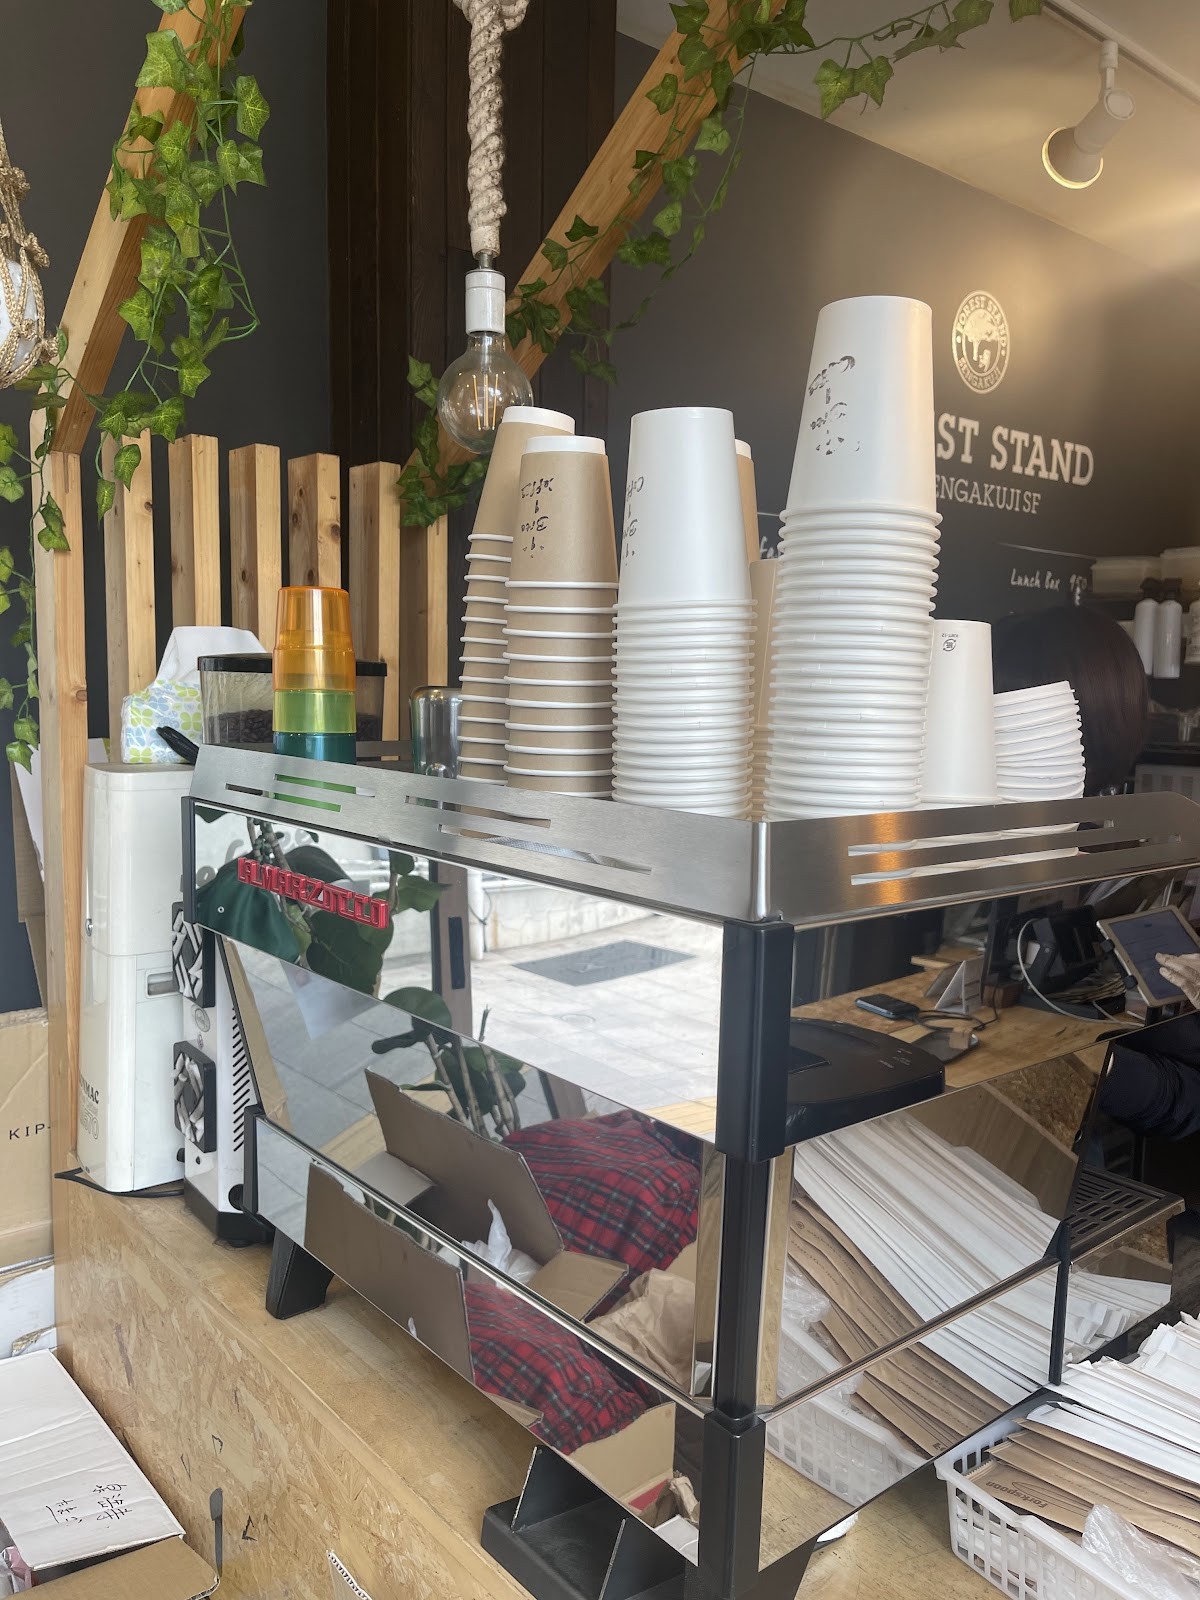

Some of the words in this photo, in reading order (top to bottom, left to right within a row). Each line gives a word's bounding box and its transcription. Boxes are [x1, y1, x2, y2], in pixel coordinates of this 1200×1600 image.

[957, 295, 985, 334] FOREST
[990, 424, 1094, 487] STAND
[1023, 490, 1042, 515] SF
[1011, 567, 1041, 589] Lunch
[1045, 570, 1060, 592] Box
[985, 1480, 1049, 1509] Forkspoon
